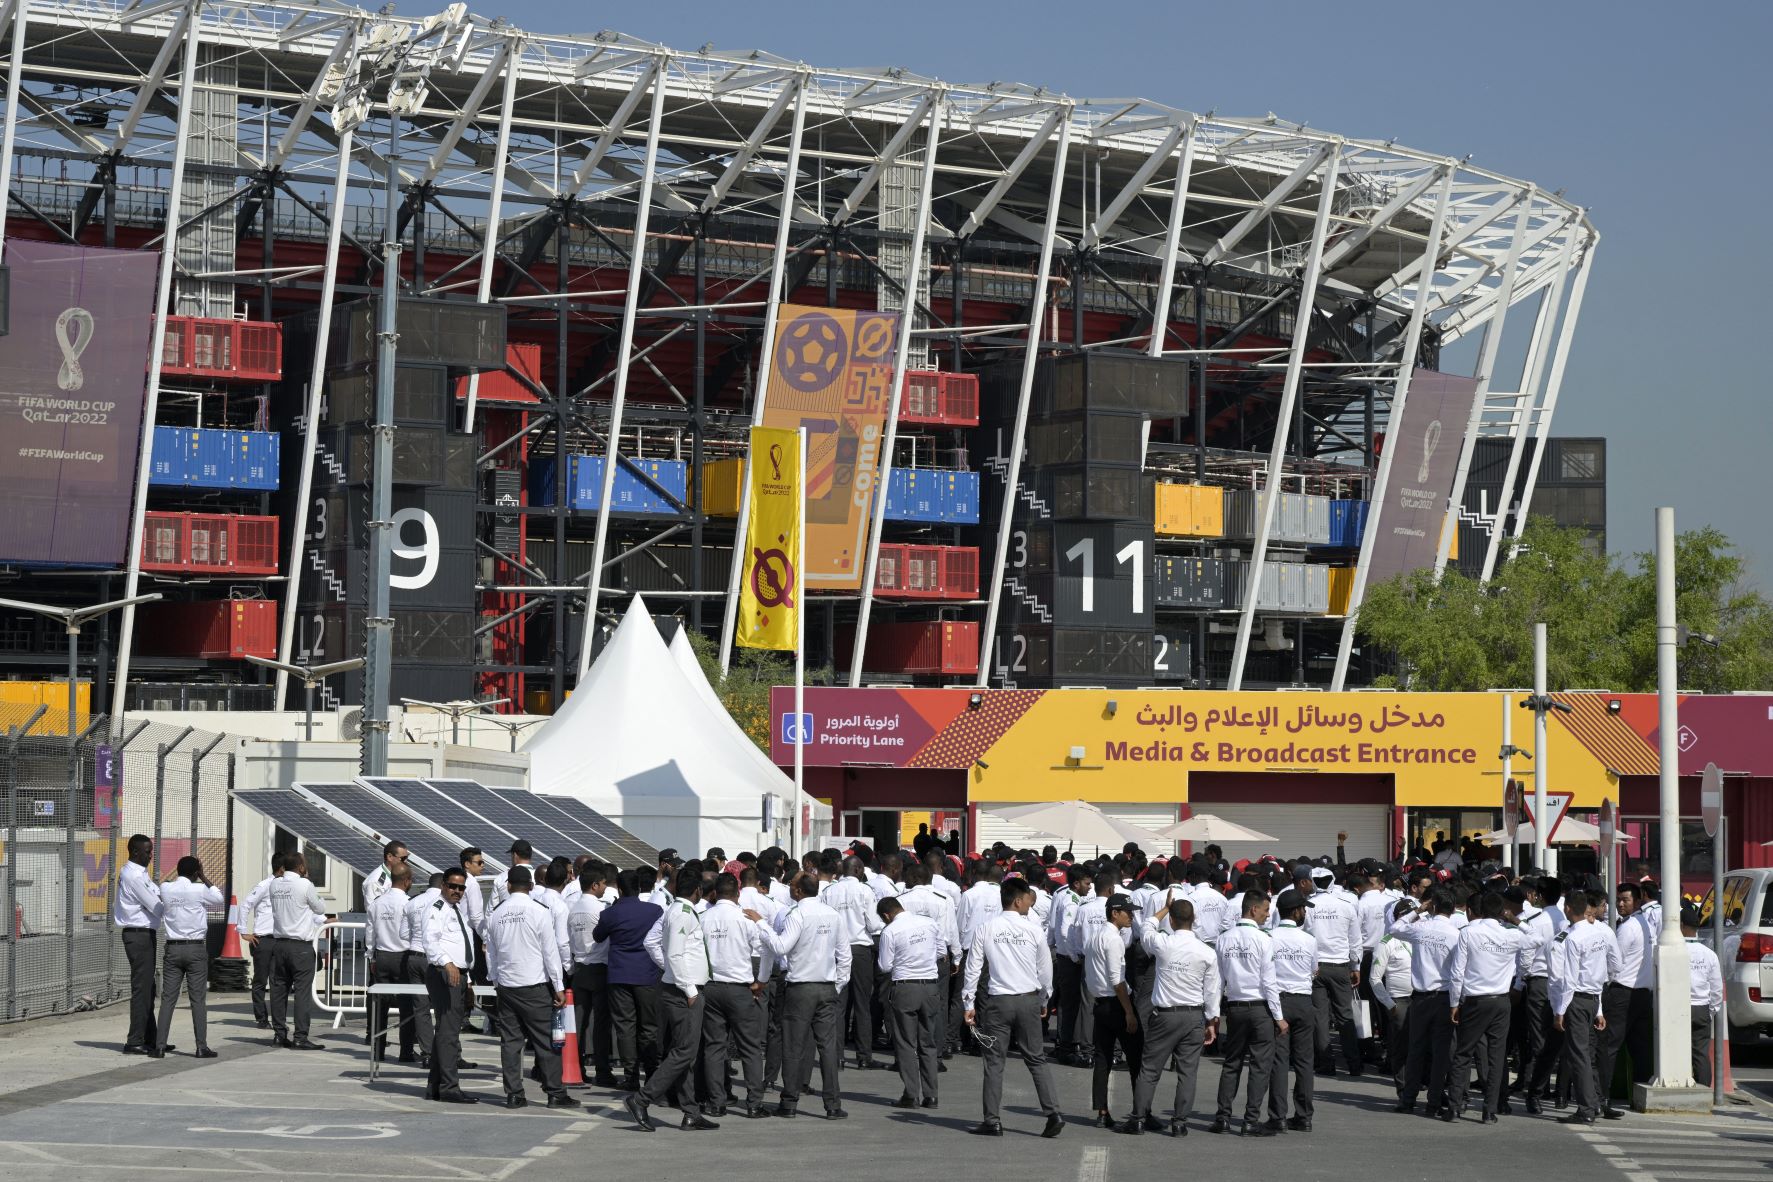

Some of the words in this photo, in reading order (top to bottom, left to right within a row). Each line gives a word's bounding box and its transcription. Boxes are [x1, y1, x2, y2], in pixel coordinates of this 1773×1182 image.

[19, 396, 44, 407] FIFA
[46, 399, 90, 410] WORLD
[92, 401, 116, 412] CUP
[18, 447, 104, 463] #FIFAWorldCup
[1401, 488, 1412, 497] FIFA
[1412, 489, 1427, 499] WORLD
[1428, 491, 1437, 500] CUP
[389, 507, 440, 590] 9
[1065, 538, 1144, 613] 11
[300, 614, 325, 657] L2
[995, 634, 1027, 672] L2
[825, 715, 860, 729] المرور
[863, 713, 899, 730] أولوية
[1135, 703, 1199, 733] والبث
[1204, 705, 1279, 736] الإعلام
[1285, 704, 1363, 733] وسائل
[1369, 704, 1446, 733] مدخل
[820, 733, 870, 748] Priority
[873, 735, 905, 746] Lane
[1680, 733, 1688, 745] F
[1105, 740, 1184, 761] Media
[1190, 741, 1210, 761] &
[1217, 742, 1351, 763] Broadcast
[1358, 743, 1477, 764] Entrance
[993, 937, 1027, 946] SECURITY
